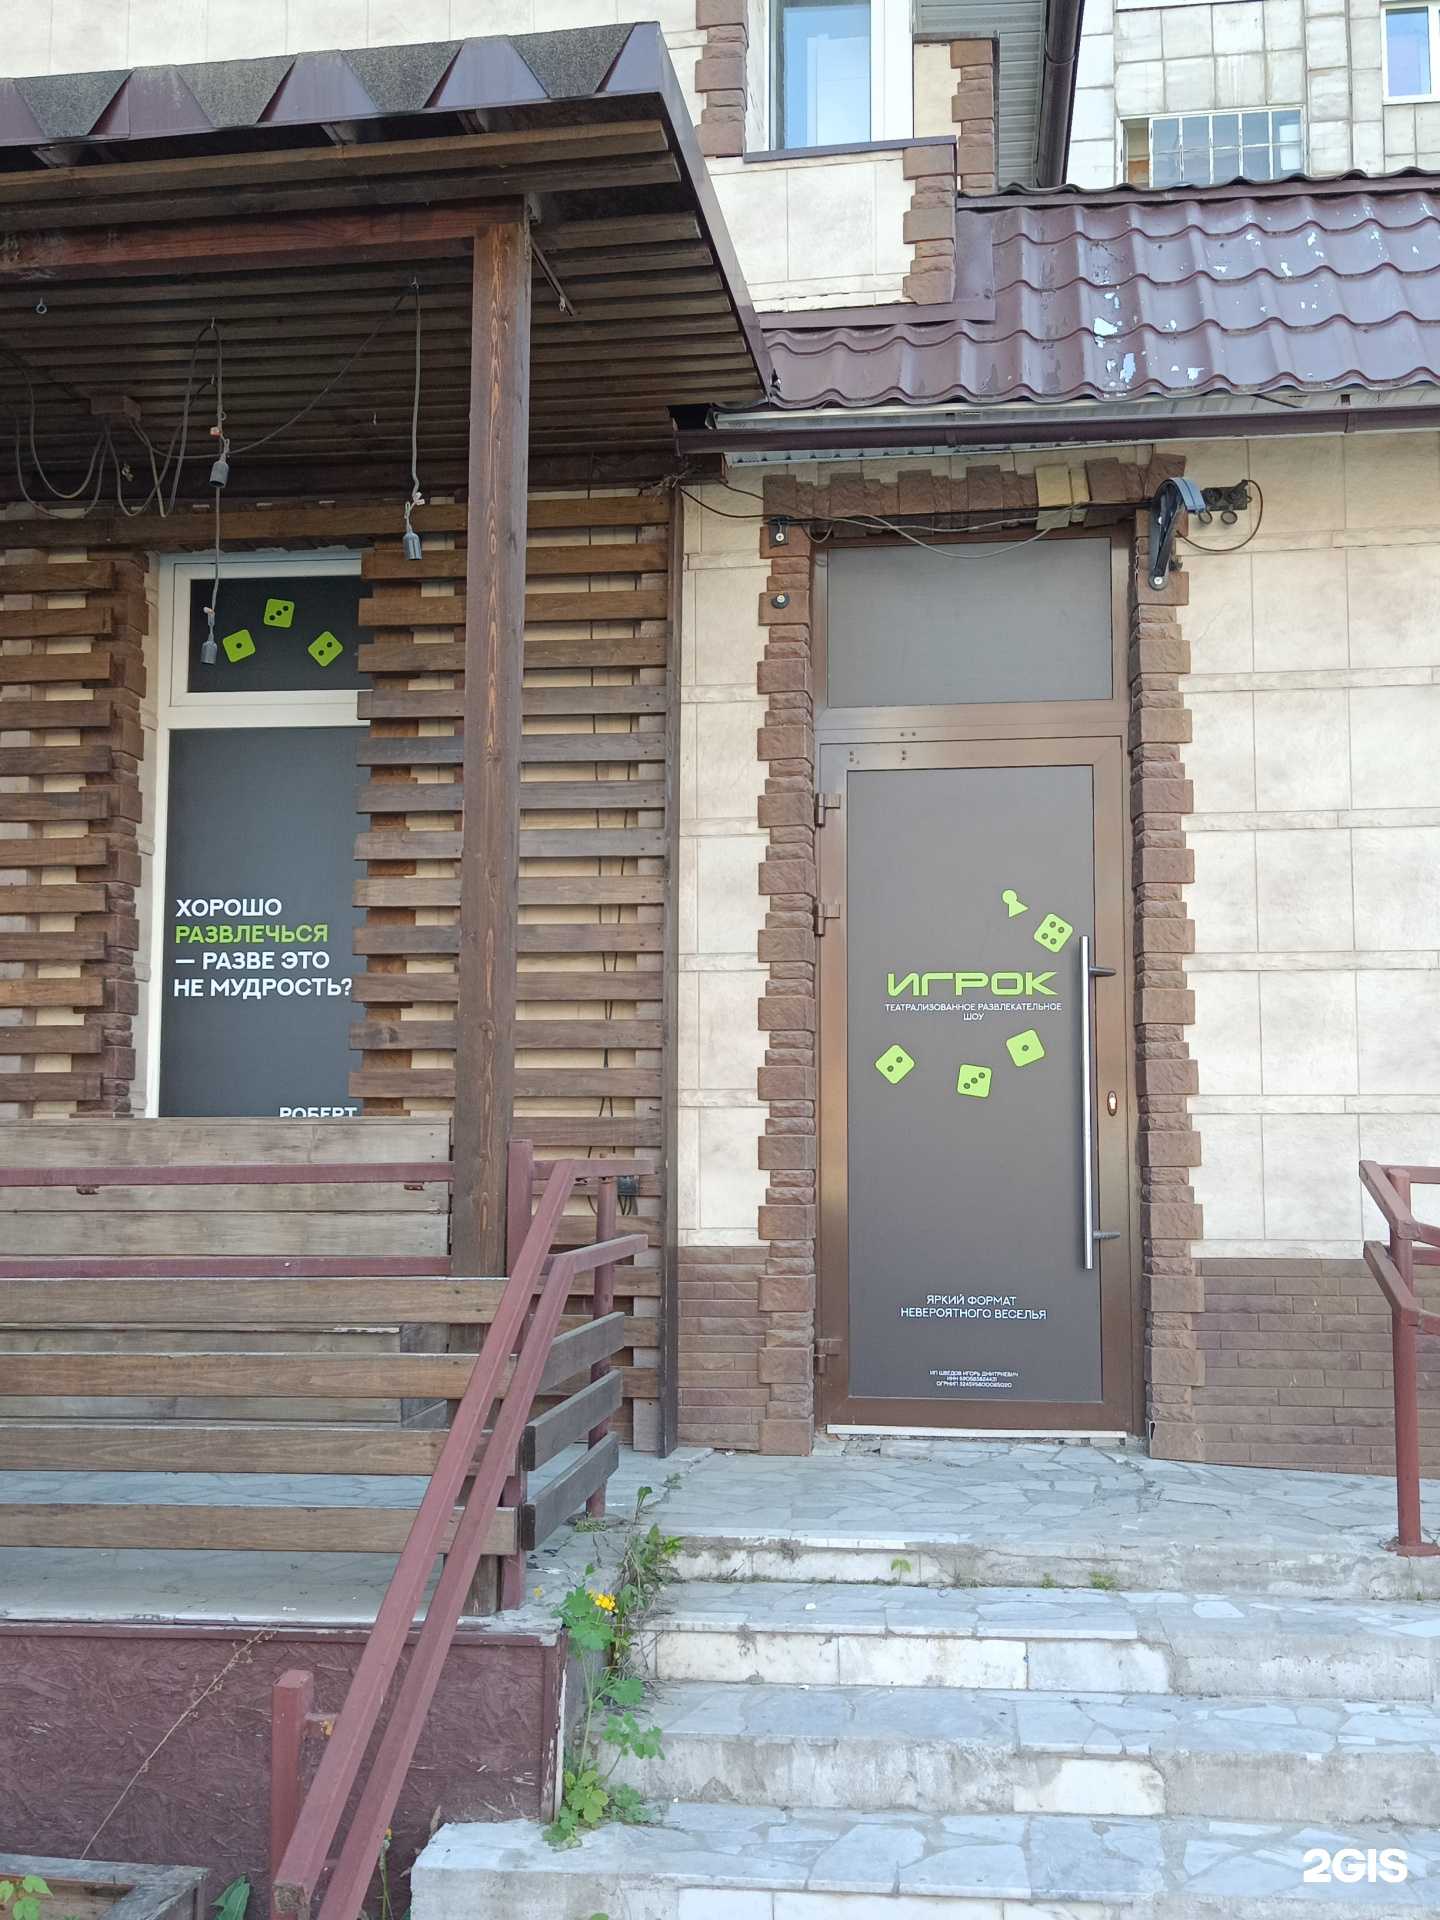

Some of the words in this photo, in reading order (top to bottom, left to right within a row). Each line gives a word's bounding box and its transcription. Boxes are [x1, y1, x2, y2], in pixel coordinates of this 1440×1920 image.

[175, 898, 283, 917] ХОРОШО
[175, 924, 329, 944] РАЗВЛЕЧЬСЯ
[203, 951, 275, 970] РАЗВЕ
[280, 951, 330, 969] ЭТО
[174, 978, 204, 997] НЕ
[210, 977, 353, 1000] МУДРОСТЬ?
[887, 972, 1059, 996] ИГРОК
[885, 1003, 976, 1011] ТЕАТРАЛИЗОВАННОЕ
[977, 1002, 1062, 1011] РАЗВЛЕКАТЕЛЬНОЕ
[963, 1012, 985, 1021] ШОУ
[926, 1294, 965, 1305] ЯРКИЙ
[967, 1296, 1016, 1306] ФОРМАТ
[900, 1307, 992, 1319] НЕВЕРОЯТНОГО
[994, 1309, 1047, 1320] ВЕСЕЛЬЯ
